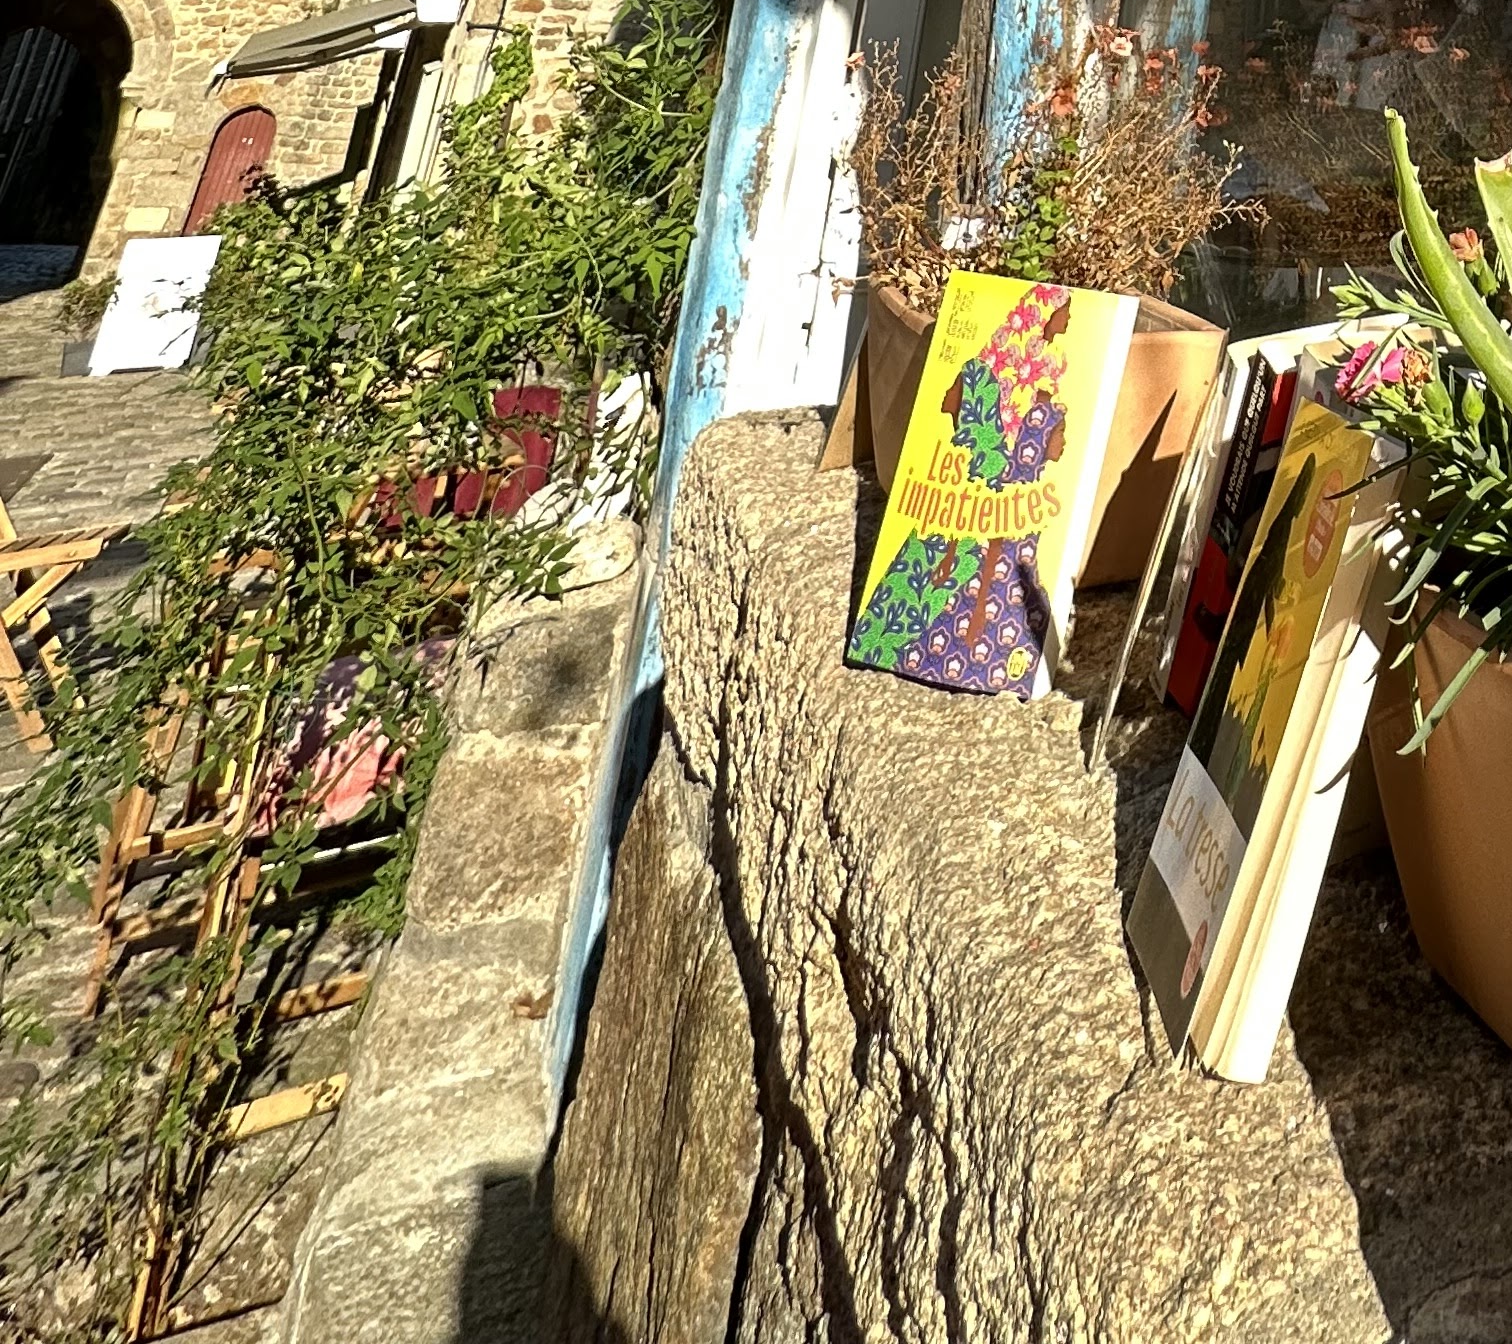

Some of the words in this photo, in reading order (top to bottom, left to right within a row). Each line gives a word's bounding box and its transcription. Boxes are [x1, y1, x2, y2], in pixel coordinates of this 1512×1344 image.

[927, 439, 966, 486] Les
[897, 467, 1062, 535] impatientes
[1166, 769, 1195, 842] La
[1184, 801, 1230, 913] tresse
